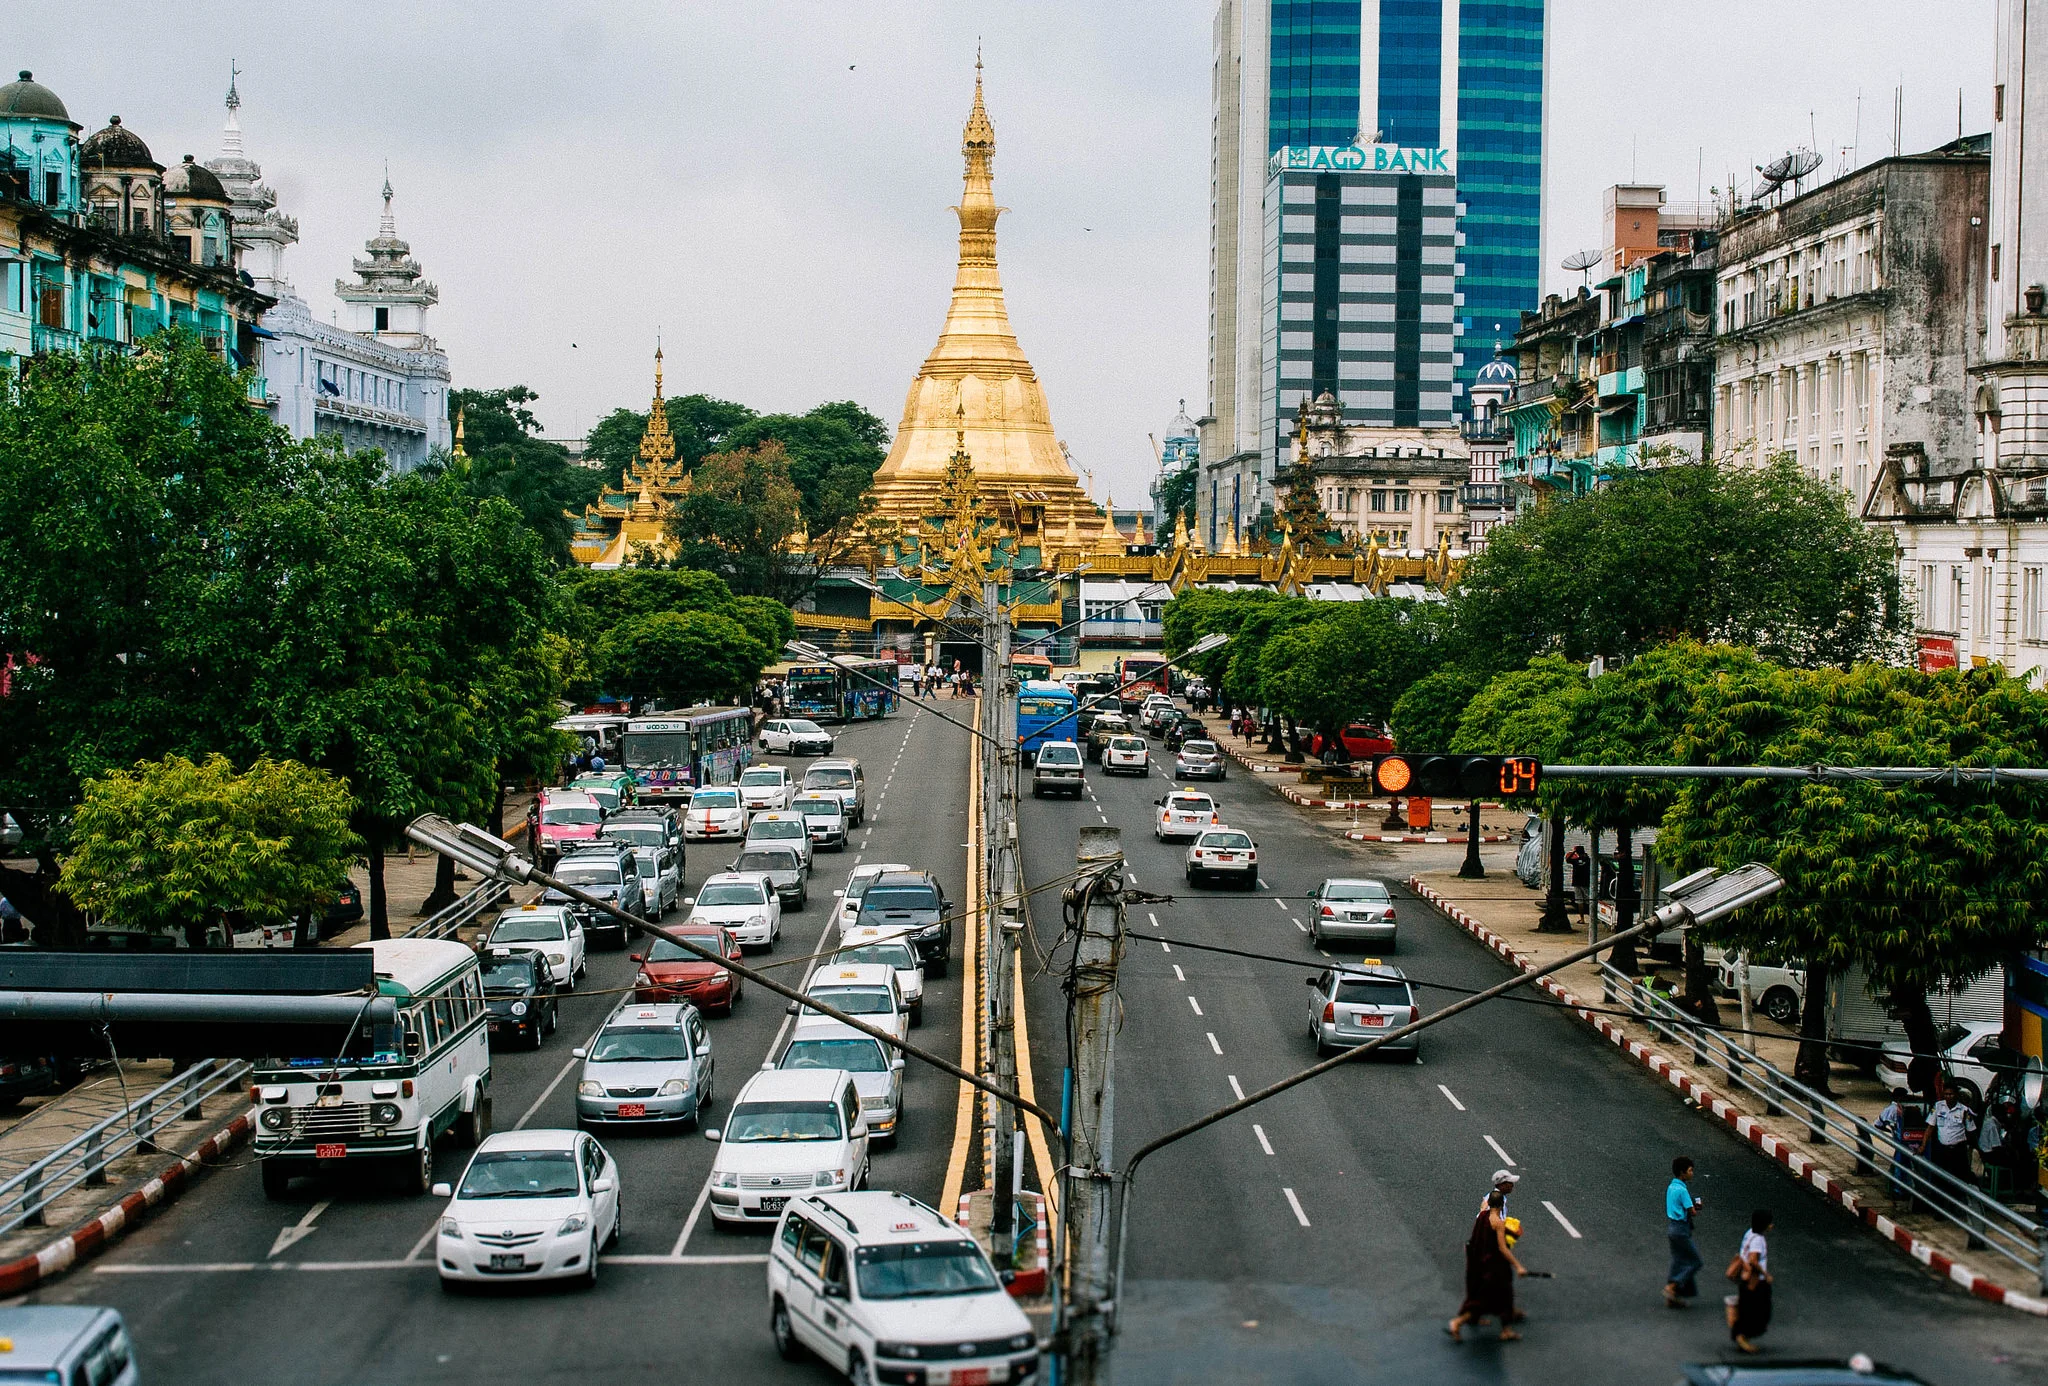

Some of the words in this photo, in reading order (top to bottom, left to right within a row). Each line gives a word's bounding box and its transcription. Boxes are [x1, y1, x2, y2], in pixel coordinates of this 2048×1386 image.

[1314, 146, 1366, 170] AGD
[1375, 148, 1449, 171] BANK
[1500, 759, 1536, 793] 04
[763, 1201, 786, 1210] 1G-633
